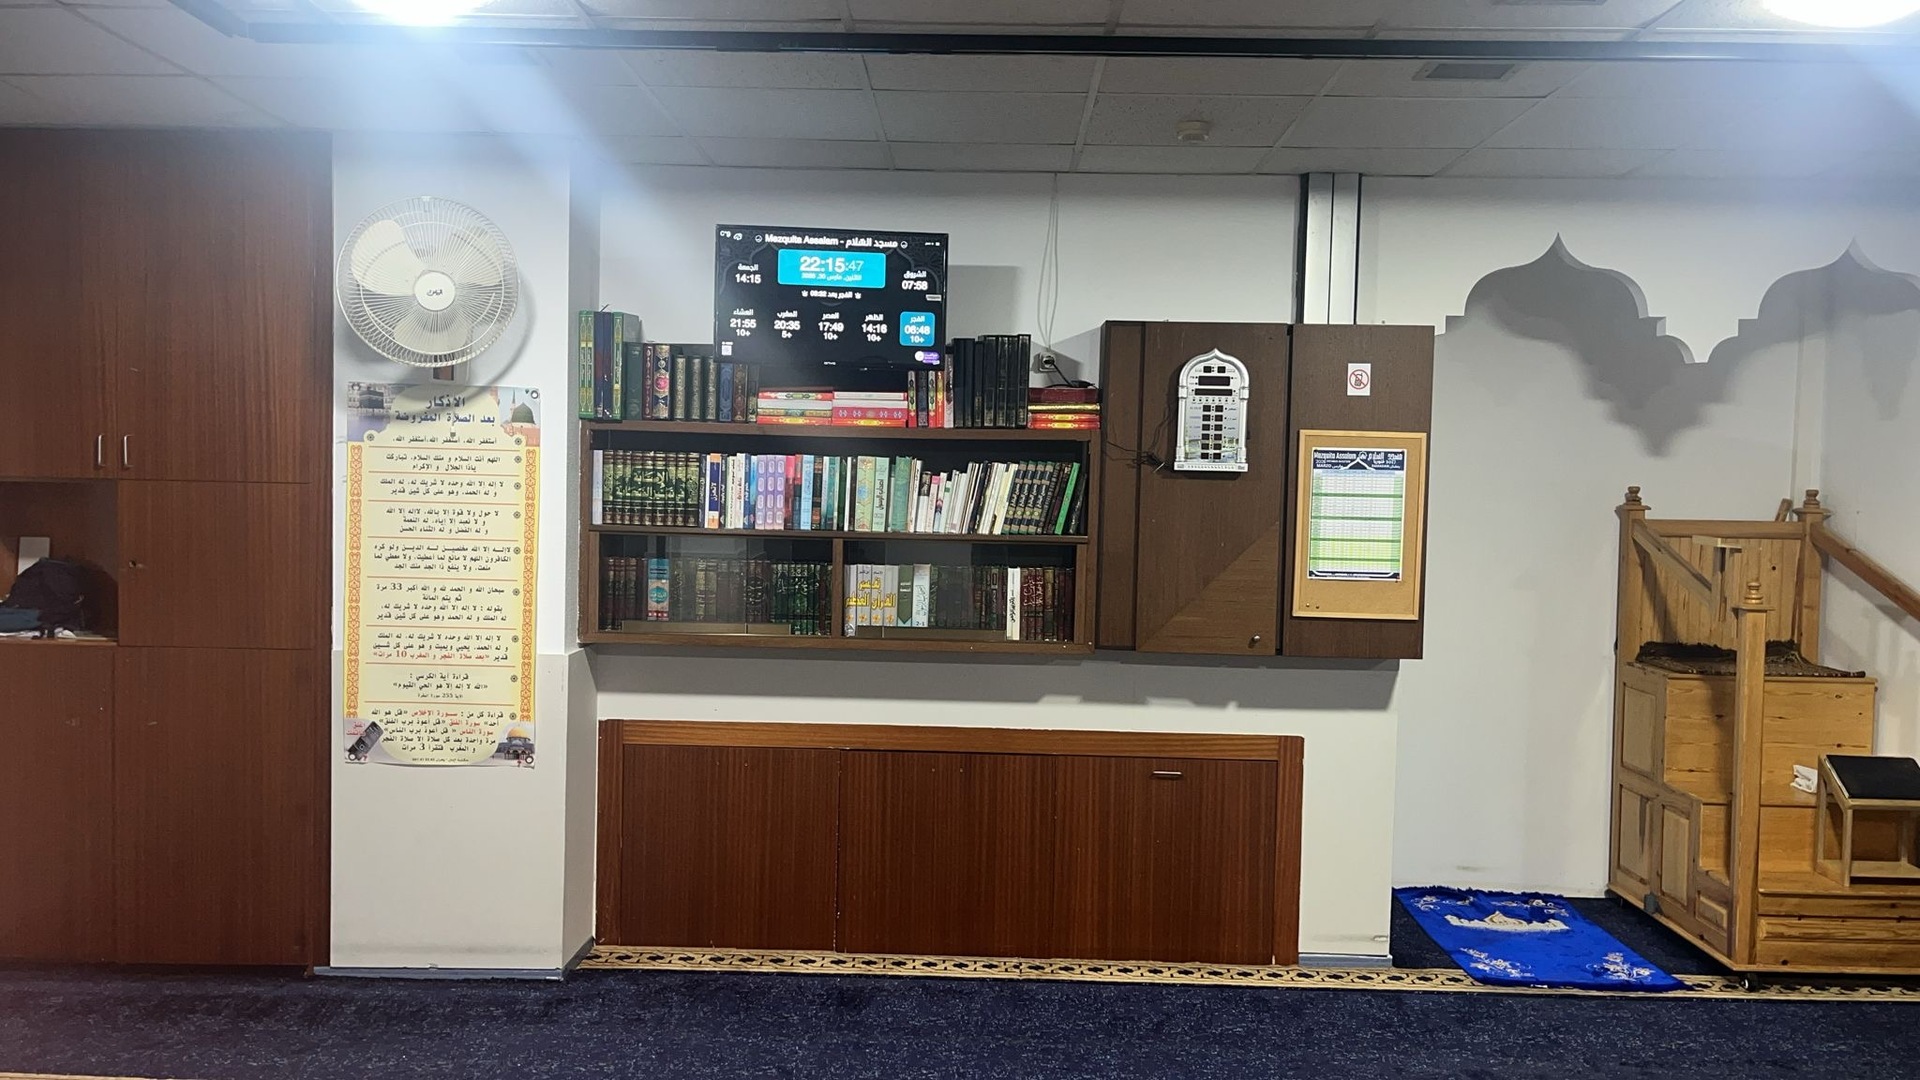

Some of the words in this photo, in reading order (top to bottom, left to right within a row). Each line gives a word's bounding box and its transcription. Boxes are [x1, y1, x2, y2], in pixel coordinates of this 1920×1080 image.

[765, 234, 802, 244] Mezquita
[804, 236, 838, 245] Assalam
[800, 256, 864, 272] 22:15:47
[735, 274, 761, 283] 14:15
[902, 280, 928, 290] 07:58
[730, 319, 756, 328] 21:55
[774, 320, 800, 330] 20:35
[818, 322, 844, 332] 17:49
[858, 576, 881, 591] تفسير
[845, 592, 869, 608] العظيم
[871, 590, 896, 609] القرآن
[452, 673, 468, 681] قراءة
